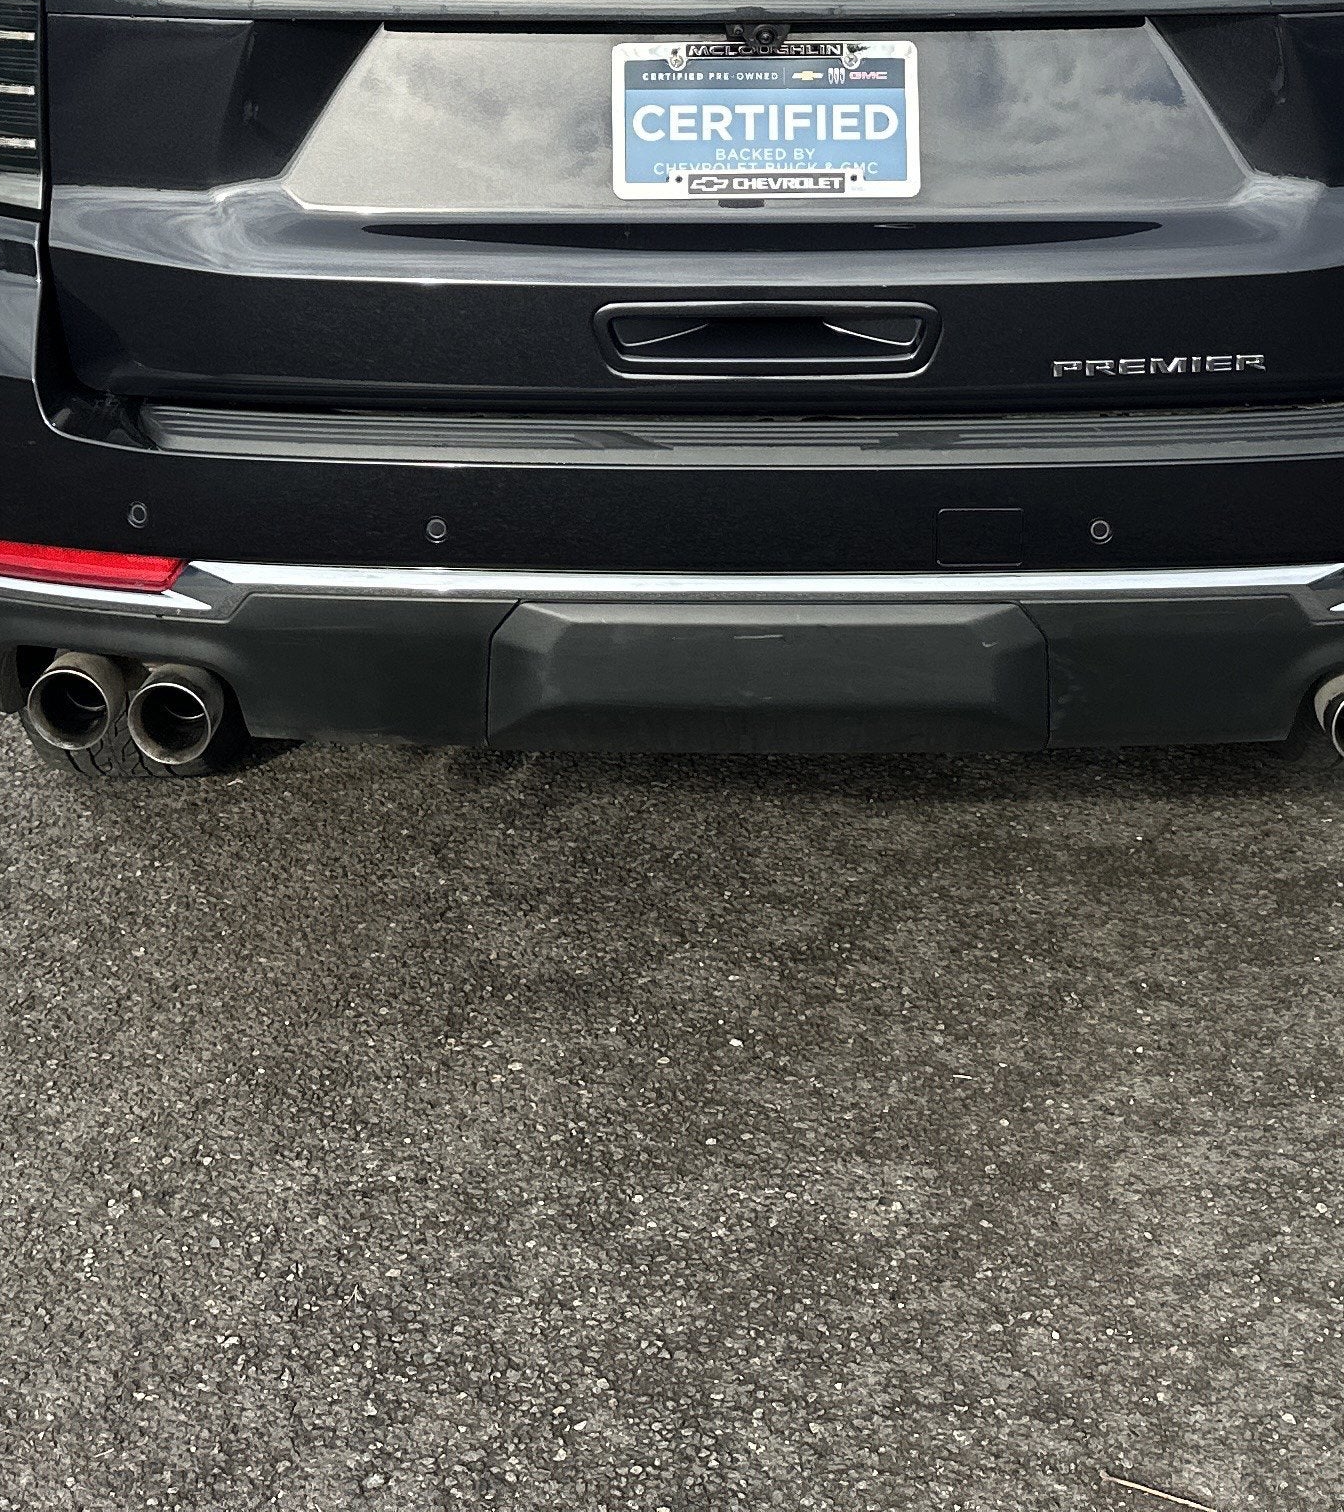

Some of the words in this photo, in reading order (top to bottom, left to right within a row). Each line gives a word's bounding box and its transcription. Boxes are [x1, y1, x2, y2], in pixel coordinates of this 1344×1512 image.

[642, 72, 704, 81] CERTIFIED
[849, 71, 888, 80] GMC
[632, 103, 900, 142] CERTIFIED
[715, 148, 787, 161] BACKED
[793, 148, 816, 160] BY
[733, 177, 844, 190] CHEVROLET
[1053, 354, 1267, 377] PREMIER
